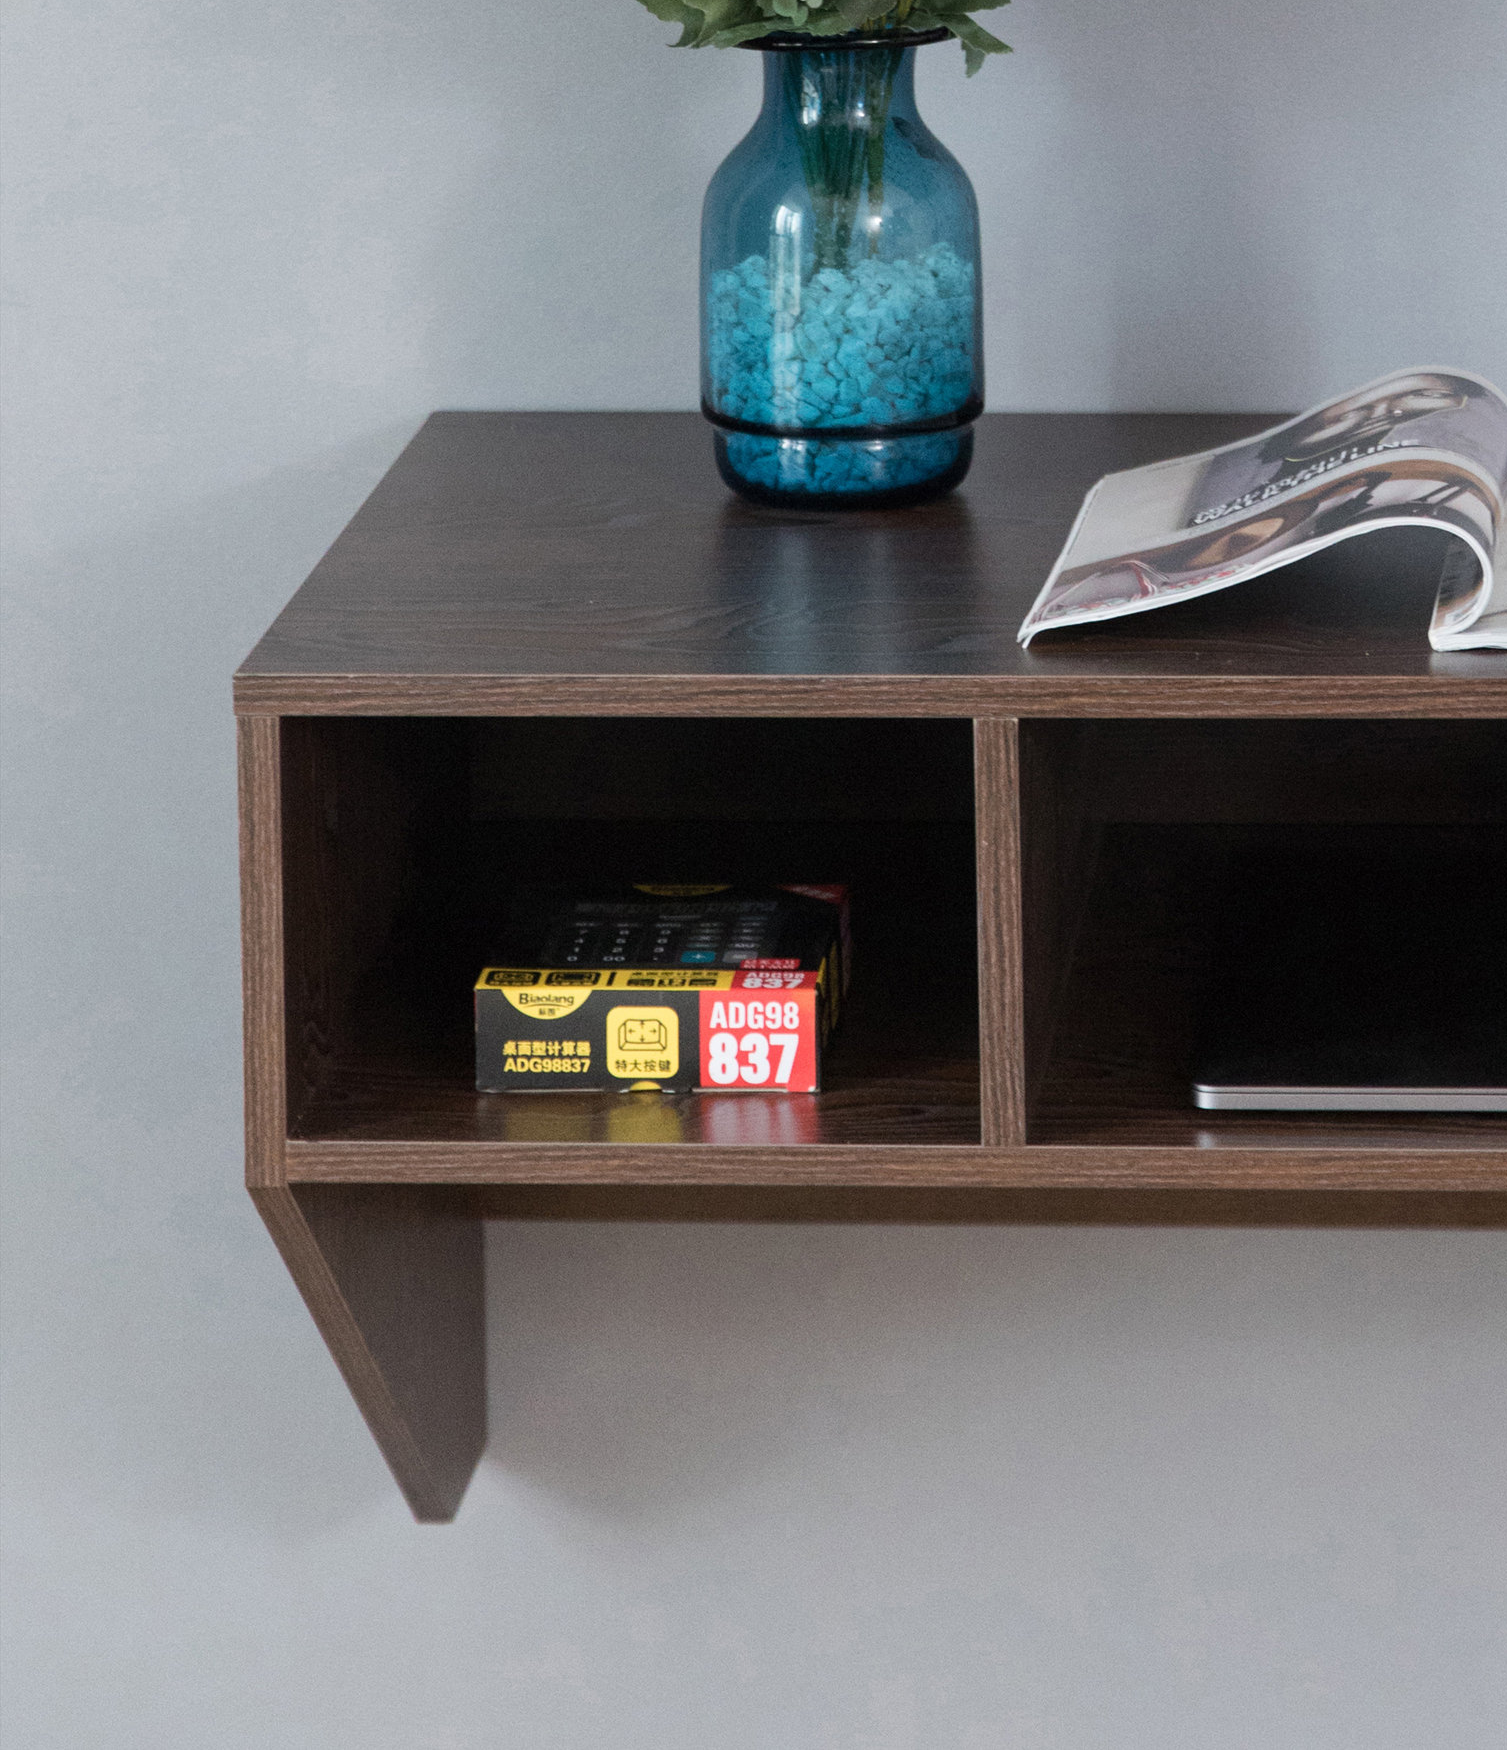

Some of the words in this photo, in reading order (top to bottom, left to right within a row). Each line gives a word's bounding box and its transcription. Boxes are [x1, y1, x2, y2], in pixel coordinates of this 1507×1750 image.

[742, 978, 804, 989] 837
[519, 993, 574, 1006] Biaolang
[710, 1001, 799, 1029] ADG98
[708, 1032, 799, 1084] 837
[503, 1058, 592, 1073] ADG98837
[615, 1059, 672, 1073] 特大按键
